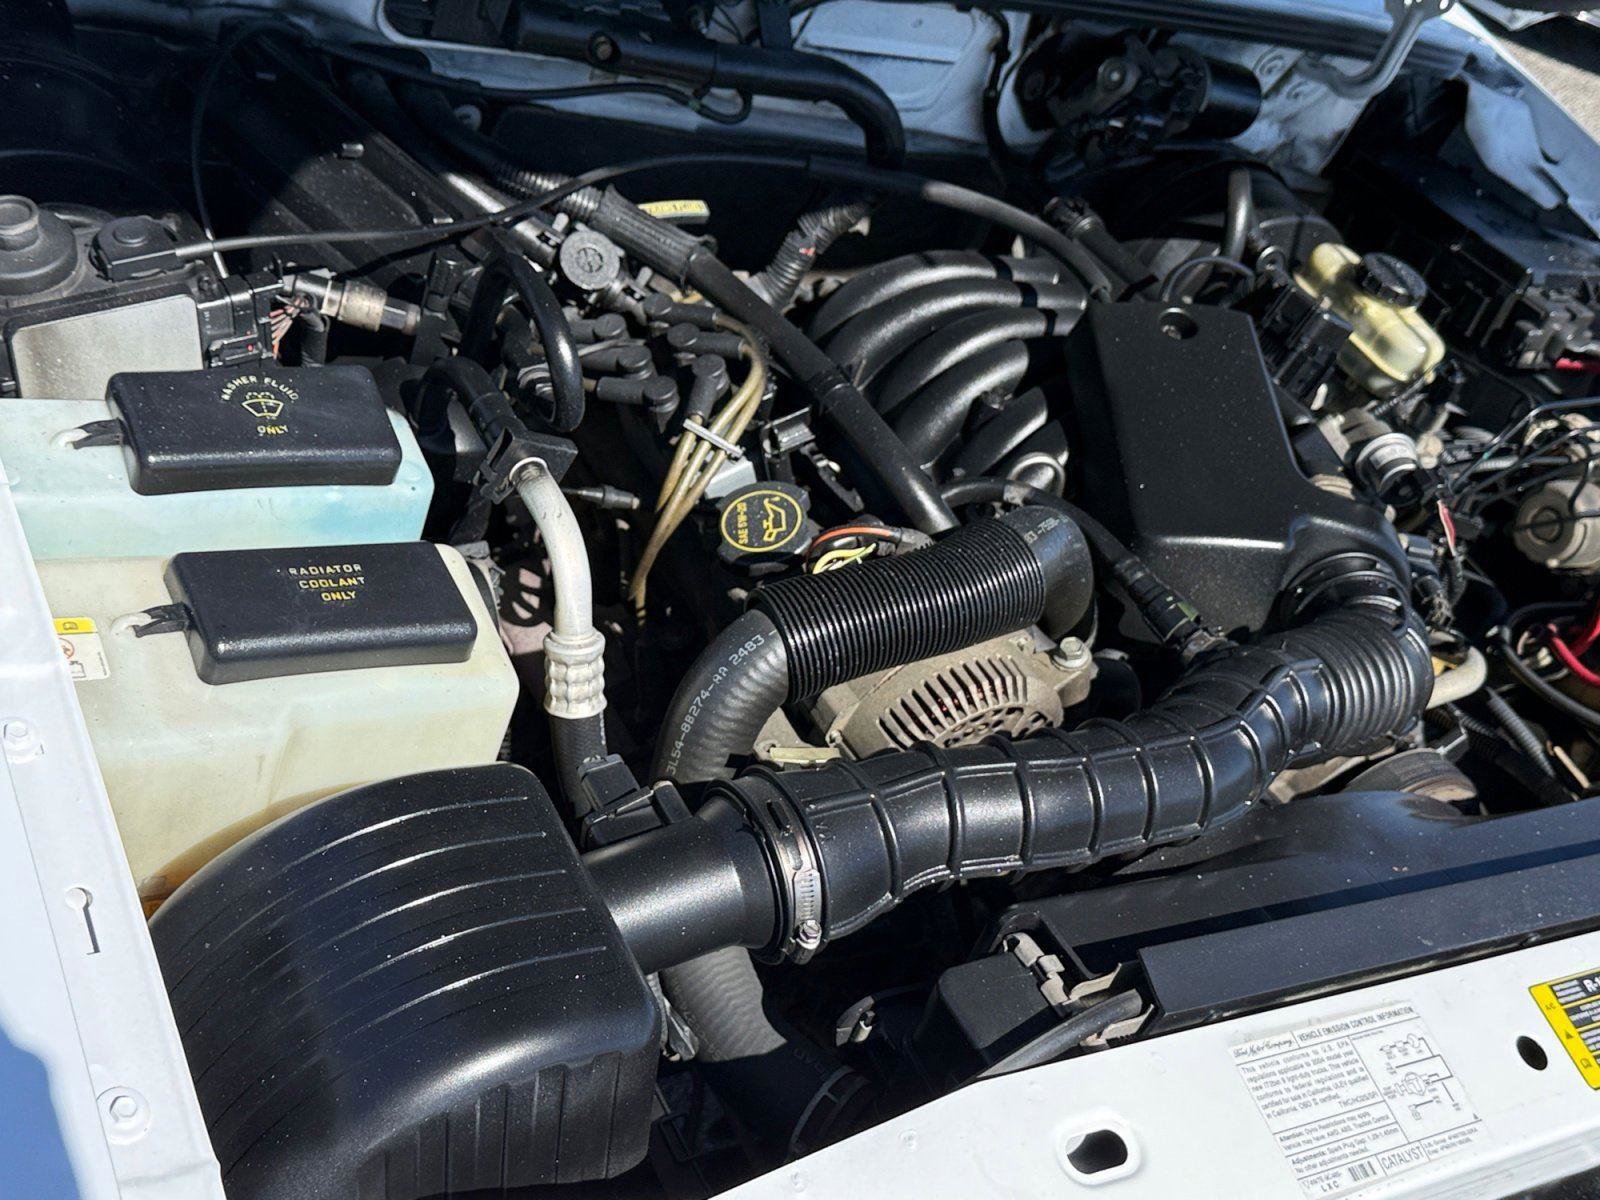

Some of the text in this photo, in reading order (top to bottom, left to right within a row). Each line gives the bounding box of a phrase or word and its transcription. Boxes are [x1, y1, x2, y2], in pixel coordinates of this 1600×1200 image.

[264, 377, 299, 400] FLUID
[257, 425, 289, 434] ONLY
[738, 529, 748, 544] SAE
[288, 563, 362, 575] RADIATOR
[299, 576, 365, 588] COOLANT
[321, 590, 356, 601] ONLY
[728, 634, 765, 666] 2483
[1297, 1029, 1323, 1042] VEHICLE
[1321, 1022, 1351, 1035] EMISSION
[1349, 1014, 1376, 1028] CONTROL
[1376, 1004, 1414, 1020] INFORMATION
[1380, 1146, 1425, 1169] CATALYST
